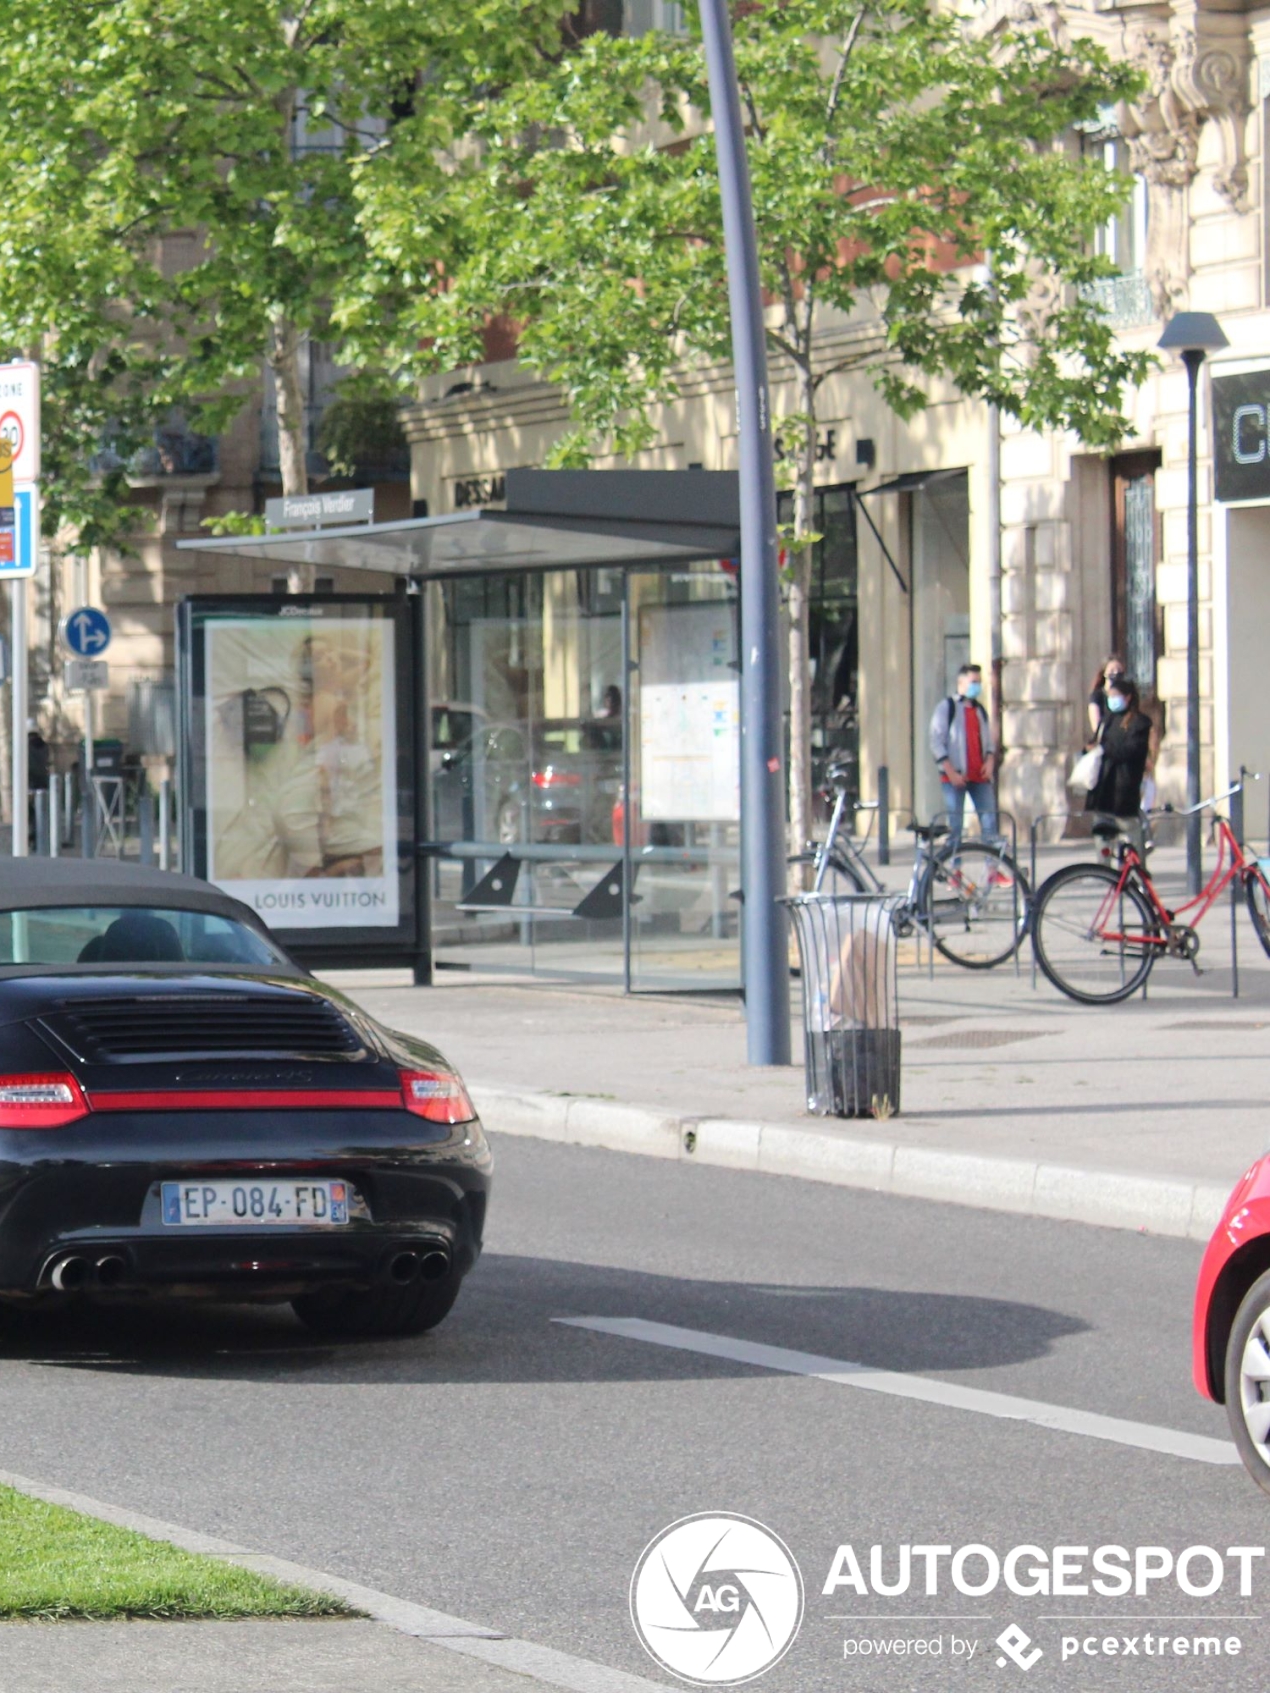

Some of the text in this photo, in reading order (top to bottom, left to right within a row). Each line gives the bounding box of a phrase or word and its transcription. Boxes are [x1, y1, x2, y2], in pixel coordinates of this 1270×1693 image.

[1233, 403, 1270, 464] C
[283, 494, 356, 521] François Verdier
[255, 892, 386, 909] LOUIS VUITTON
[185, 1187, 328, 1219] EP-084-FD
